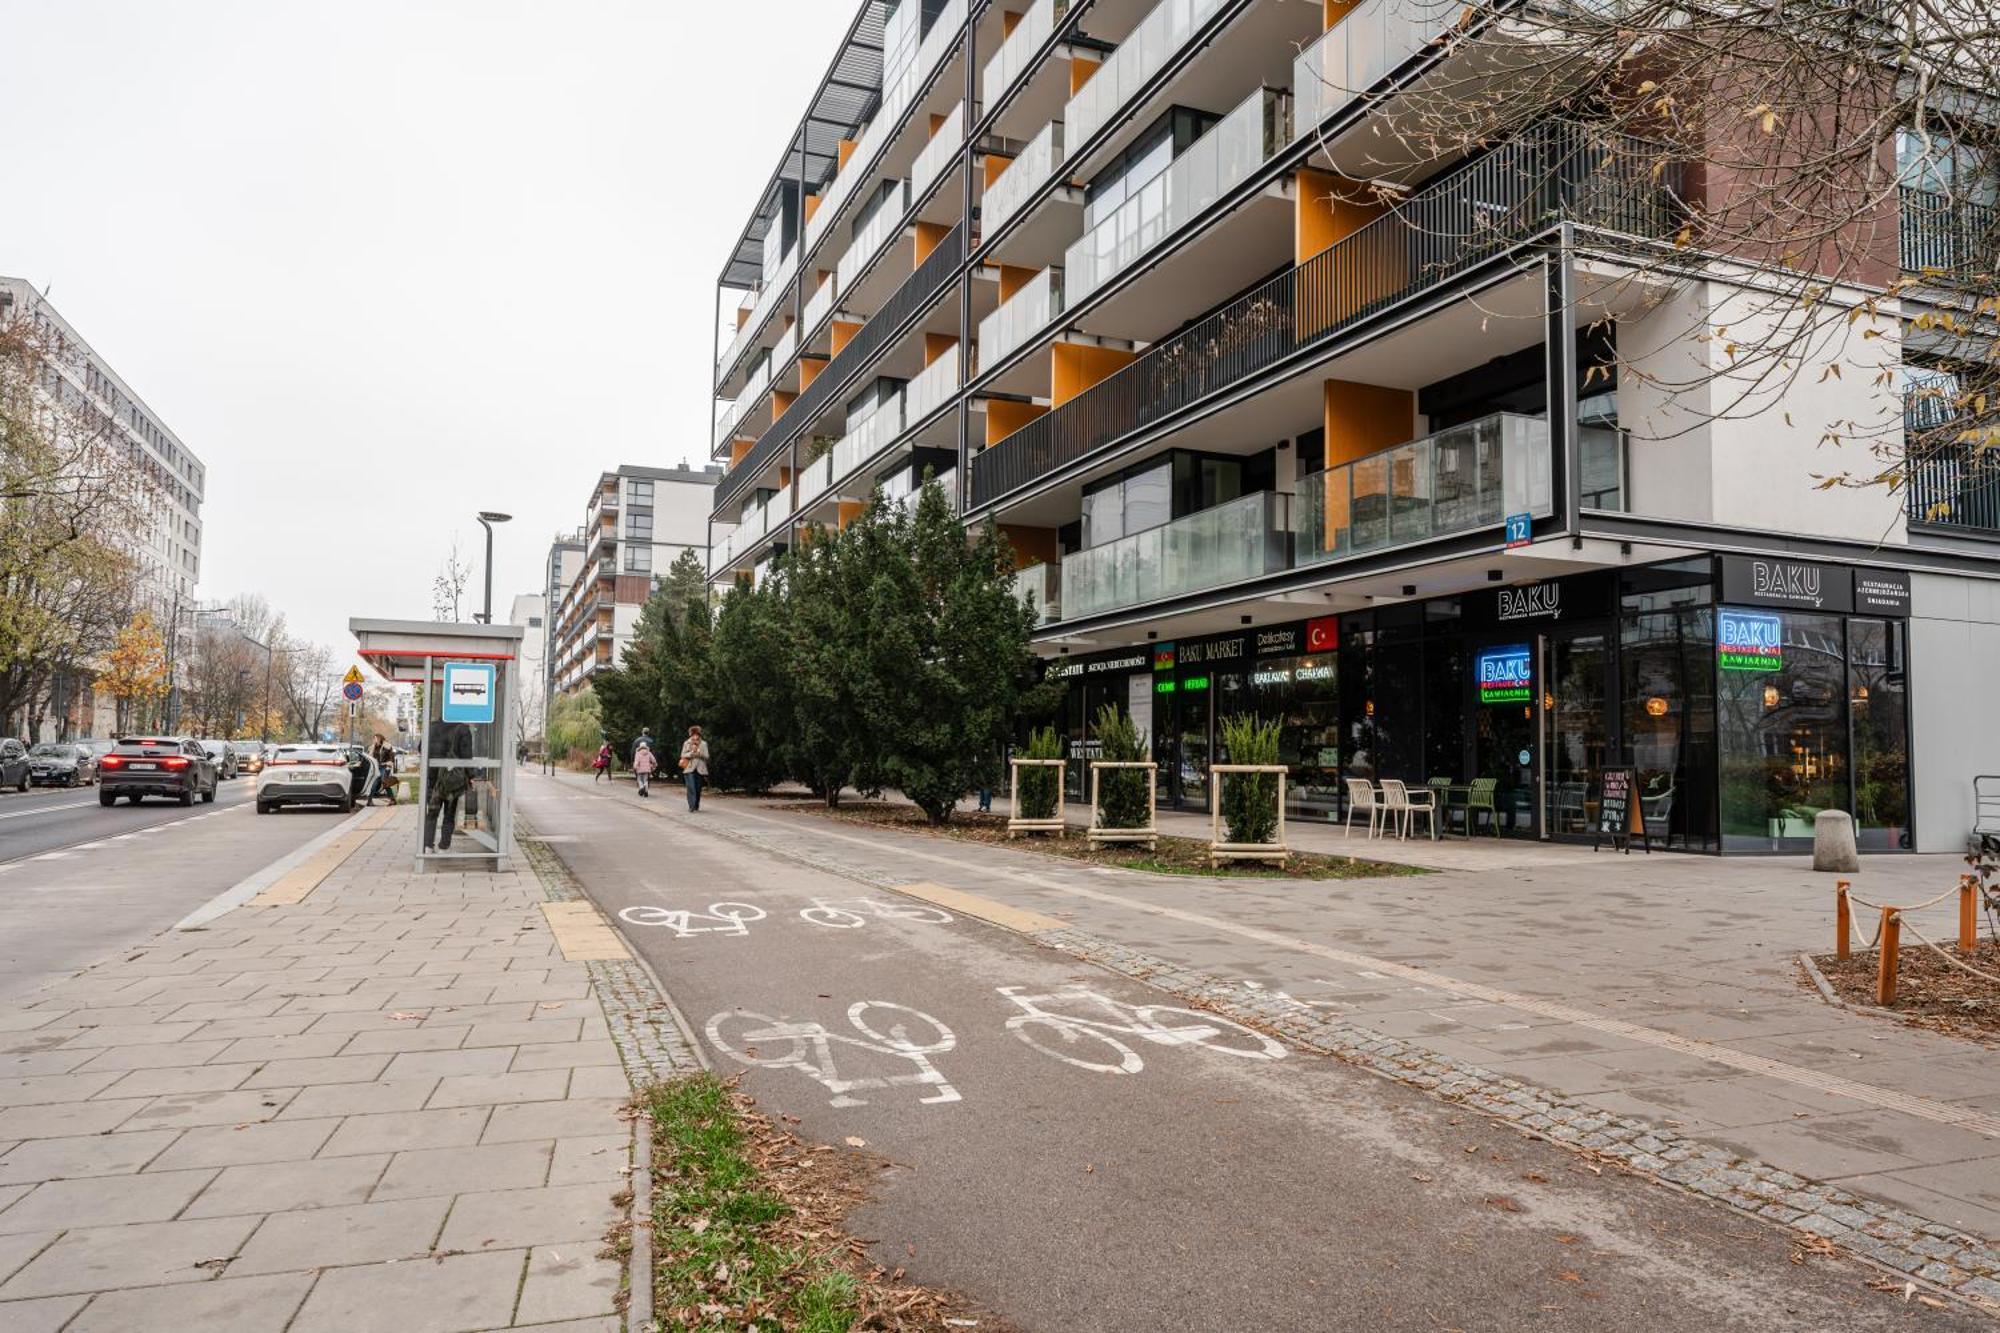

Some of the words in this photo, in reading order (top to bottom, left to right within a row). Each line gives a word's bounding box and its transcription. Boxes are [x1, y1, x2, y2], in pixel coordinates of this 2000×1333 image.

[1511, 522, 1526, 540] 12
[1753, 561, 1820, 596] BAKU
[1498, 582, 1559, 616] BAKU
[1723, 619, 1778, 647] BAKU
[1179, 643, 1202, 664] BAKU
[1206, 638, 1245, 660] MARKET
[1721, 653, 1778, 666] KAWIARNIA
[1484, 659, 1530, 681] BAKU
